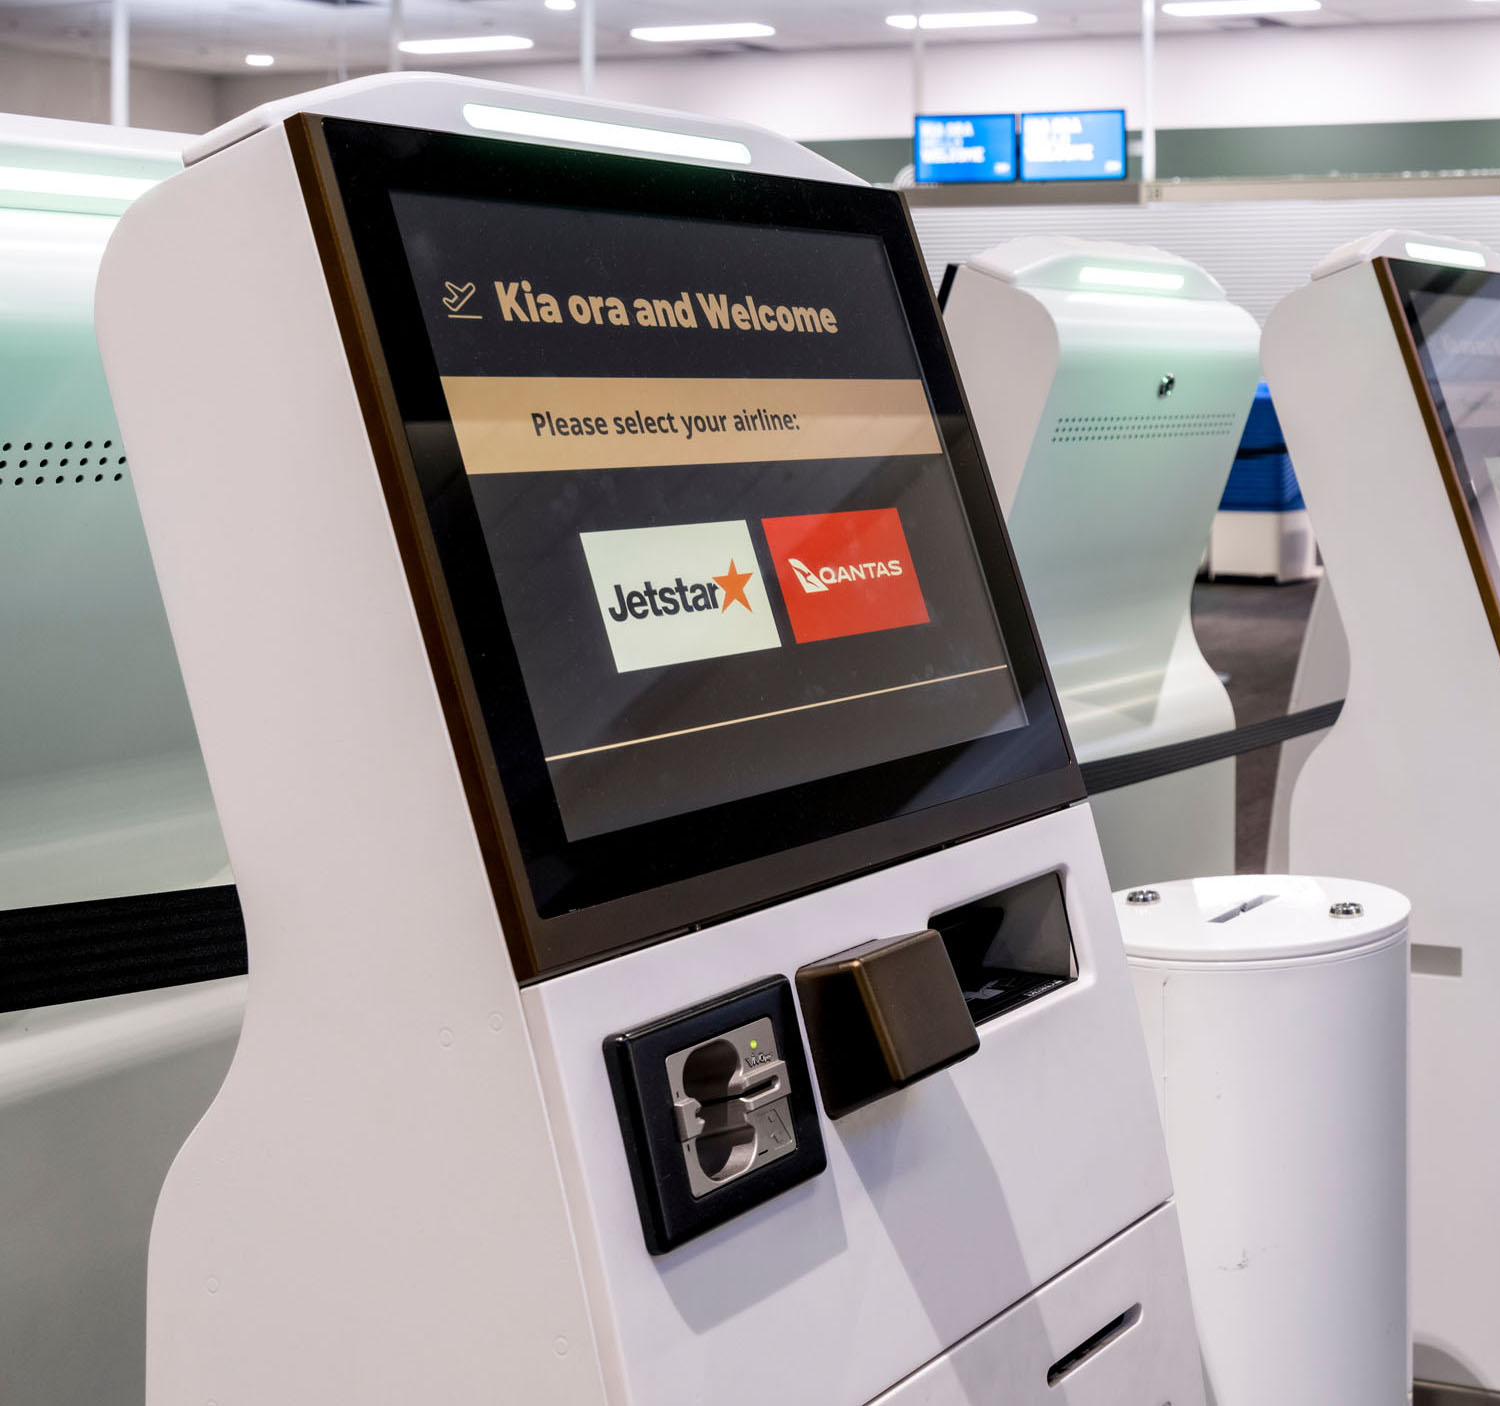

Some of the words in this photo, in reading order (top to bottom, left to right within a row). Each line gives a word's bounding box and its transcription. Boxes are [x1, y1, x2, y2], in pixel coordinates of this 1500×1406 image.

[494, 280, 563, 324] Kia
[568, 294, 630, 327] ora
[633, 292, 699, 330] and
[696, 293, 839, 335] Welcome
[531, 410, 609, 437] Please
[612, 409, 677, 436] select
[680, 412, 728, 440] your
[733, 408, 801, 434] airline:
[818, 559, 904, 586] QANTAS
[608, 577, 720, 622] Jetstar
